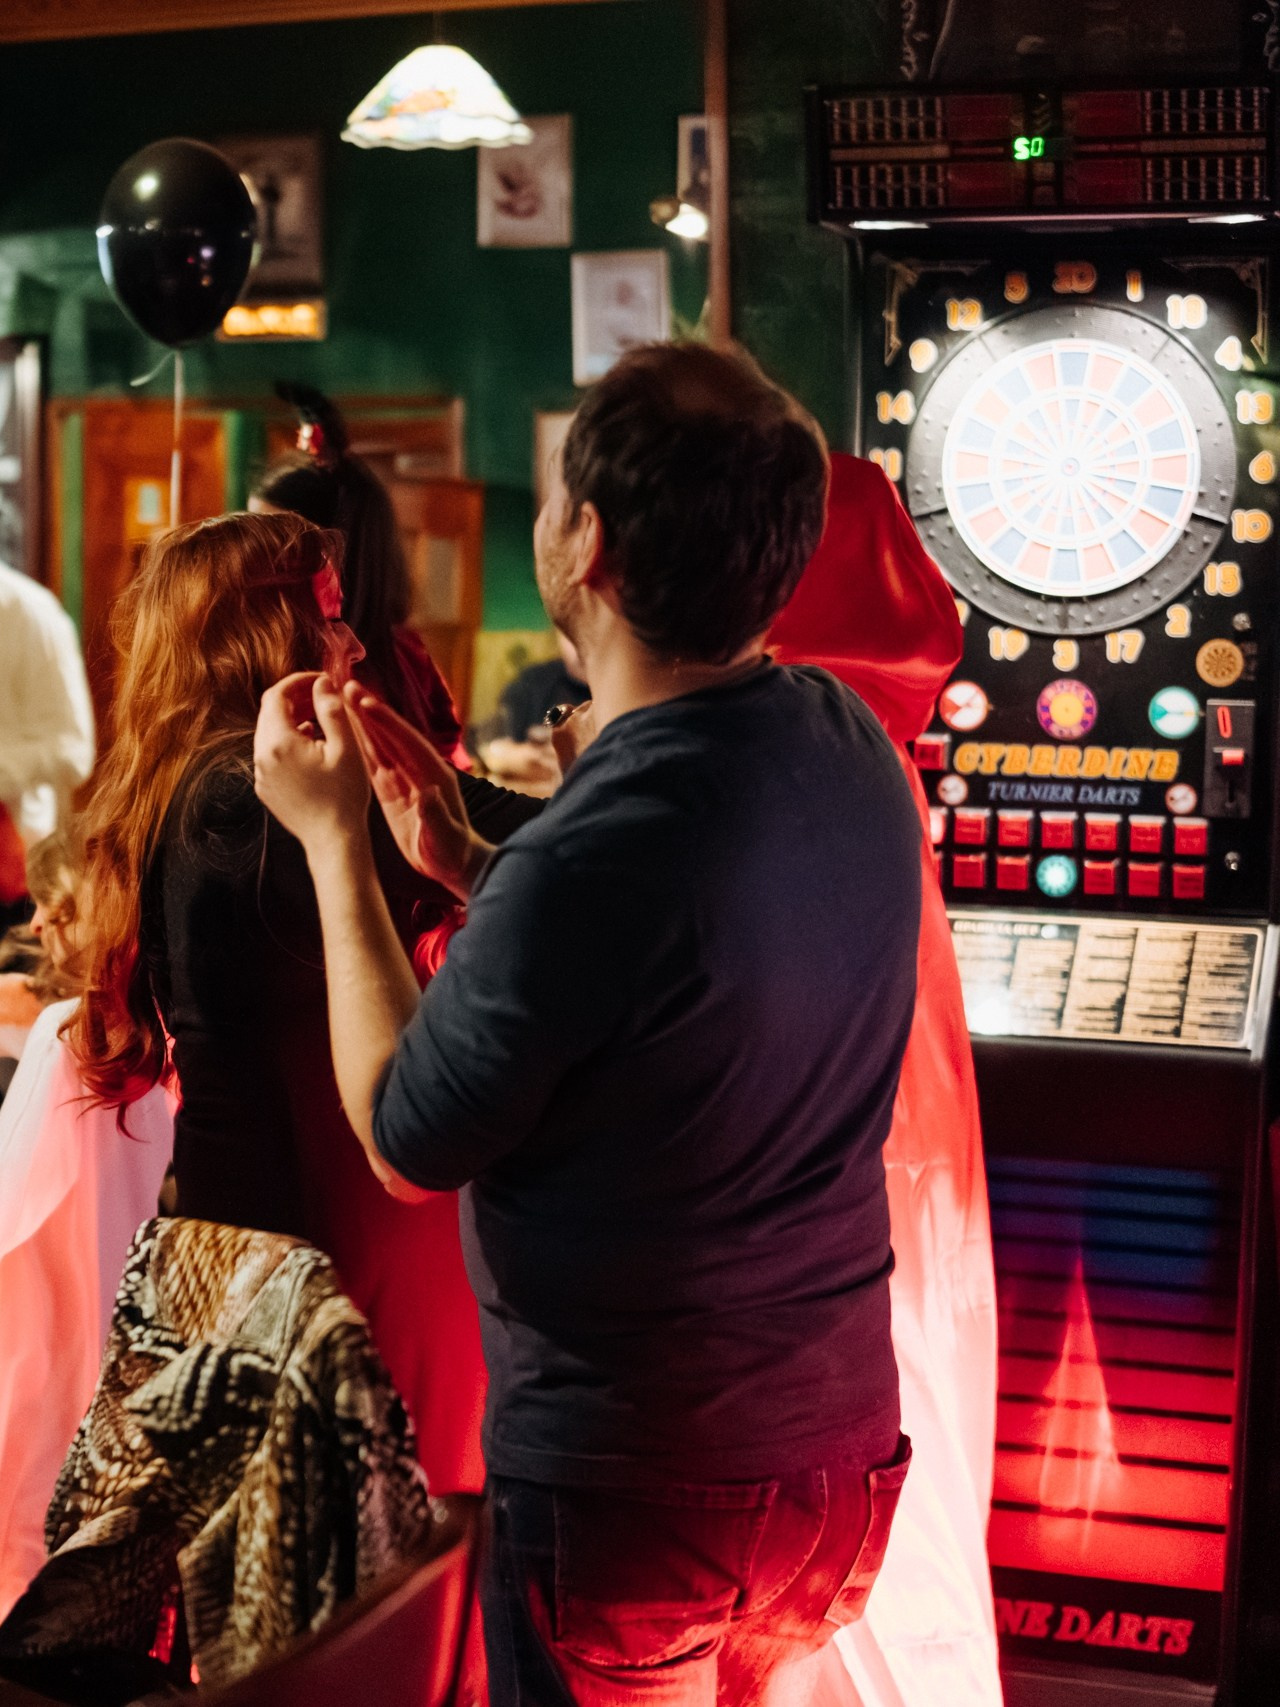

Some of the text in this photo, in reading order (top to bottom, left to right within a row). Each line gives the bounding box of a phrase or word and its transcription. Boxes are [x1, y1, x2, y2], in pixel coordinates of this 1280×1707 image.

[1052, 261, 1097, 294] 20
[1126, 269, 1144, 302] 1
[946, 298, 984, 331] 12
[1214, 336, 1242, 371] 4
[876, 390, 917, 425] 14
[1235, 390, 1275, 425] 13
[1248, 450, 1276, 484] 6
[1230, 508, 1272, 543] 10
[1203, 561, 1243, 597] 15
[1164, 603, 1192, 638] 2
[987, 626, 1029, 661] 19
[1052, 638, 1080, 672] 3
[1104, 628, 1145, 663] 17
[953, 742, 1180, 782] CYBERDINE
[987, 781, 1141, 806] TURNIER DARTS
[1053, 1605, 1194, 1655] DARTS
